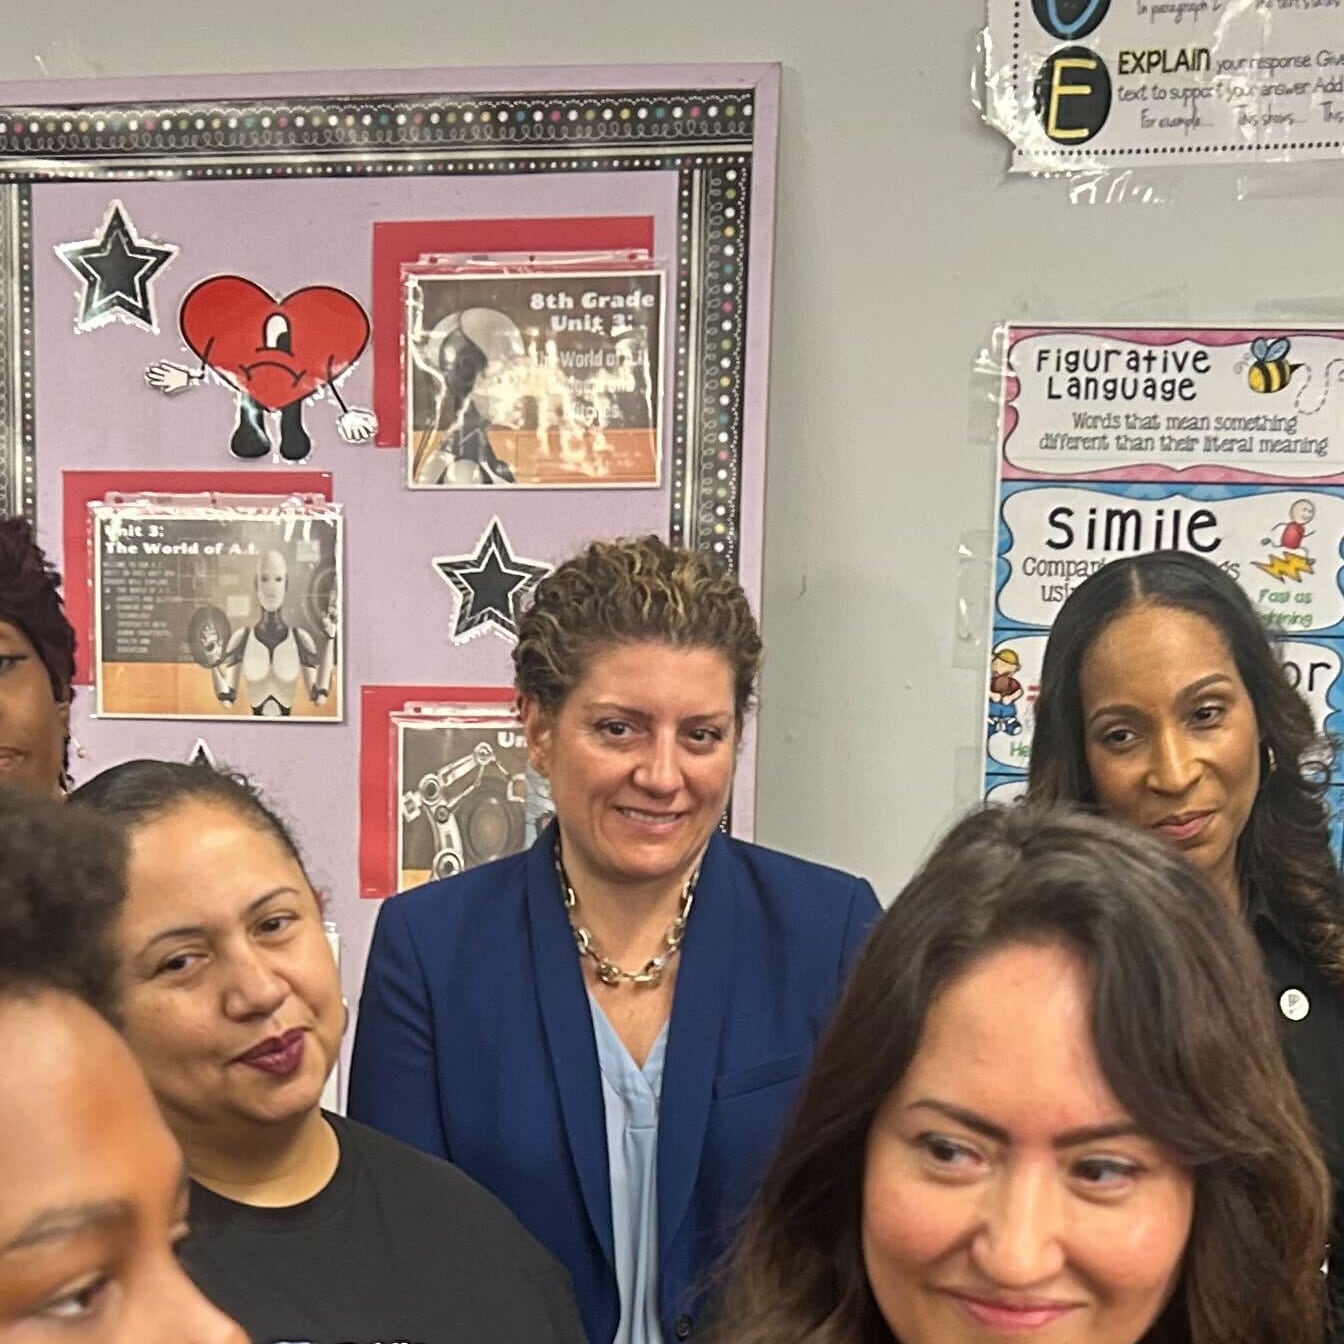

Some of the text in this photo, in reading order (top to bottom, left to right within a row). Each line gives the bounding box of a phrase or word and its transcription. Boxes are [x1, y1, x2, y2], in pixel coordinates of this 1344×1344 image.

[1118, 48, 1211, 75] EXPLAIN
[1216, 58, 1247, 75] your
[1118, 83, 1147, 101] text
[1152, 84, 1167, 100] to
[1313, 75, 1344, 94] Add
[530, 290, 655, 310] 8th Grade
[550, 313, 603, 332] Unit
[1036, 348, 1212, 374] Figurative
[1047, 376, 1198, 401] Language
[1072, 411, 1299, 435] Words that mean something
[1039, 432, 1329, 458] different than their literal meaning
[1045, 507, 1223, 553] Simile
[105, 542, 138, 555] The
[142, 542, 200, 555] World
[204, 542, 224, 555] of
